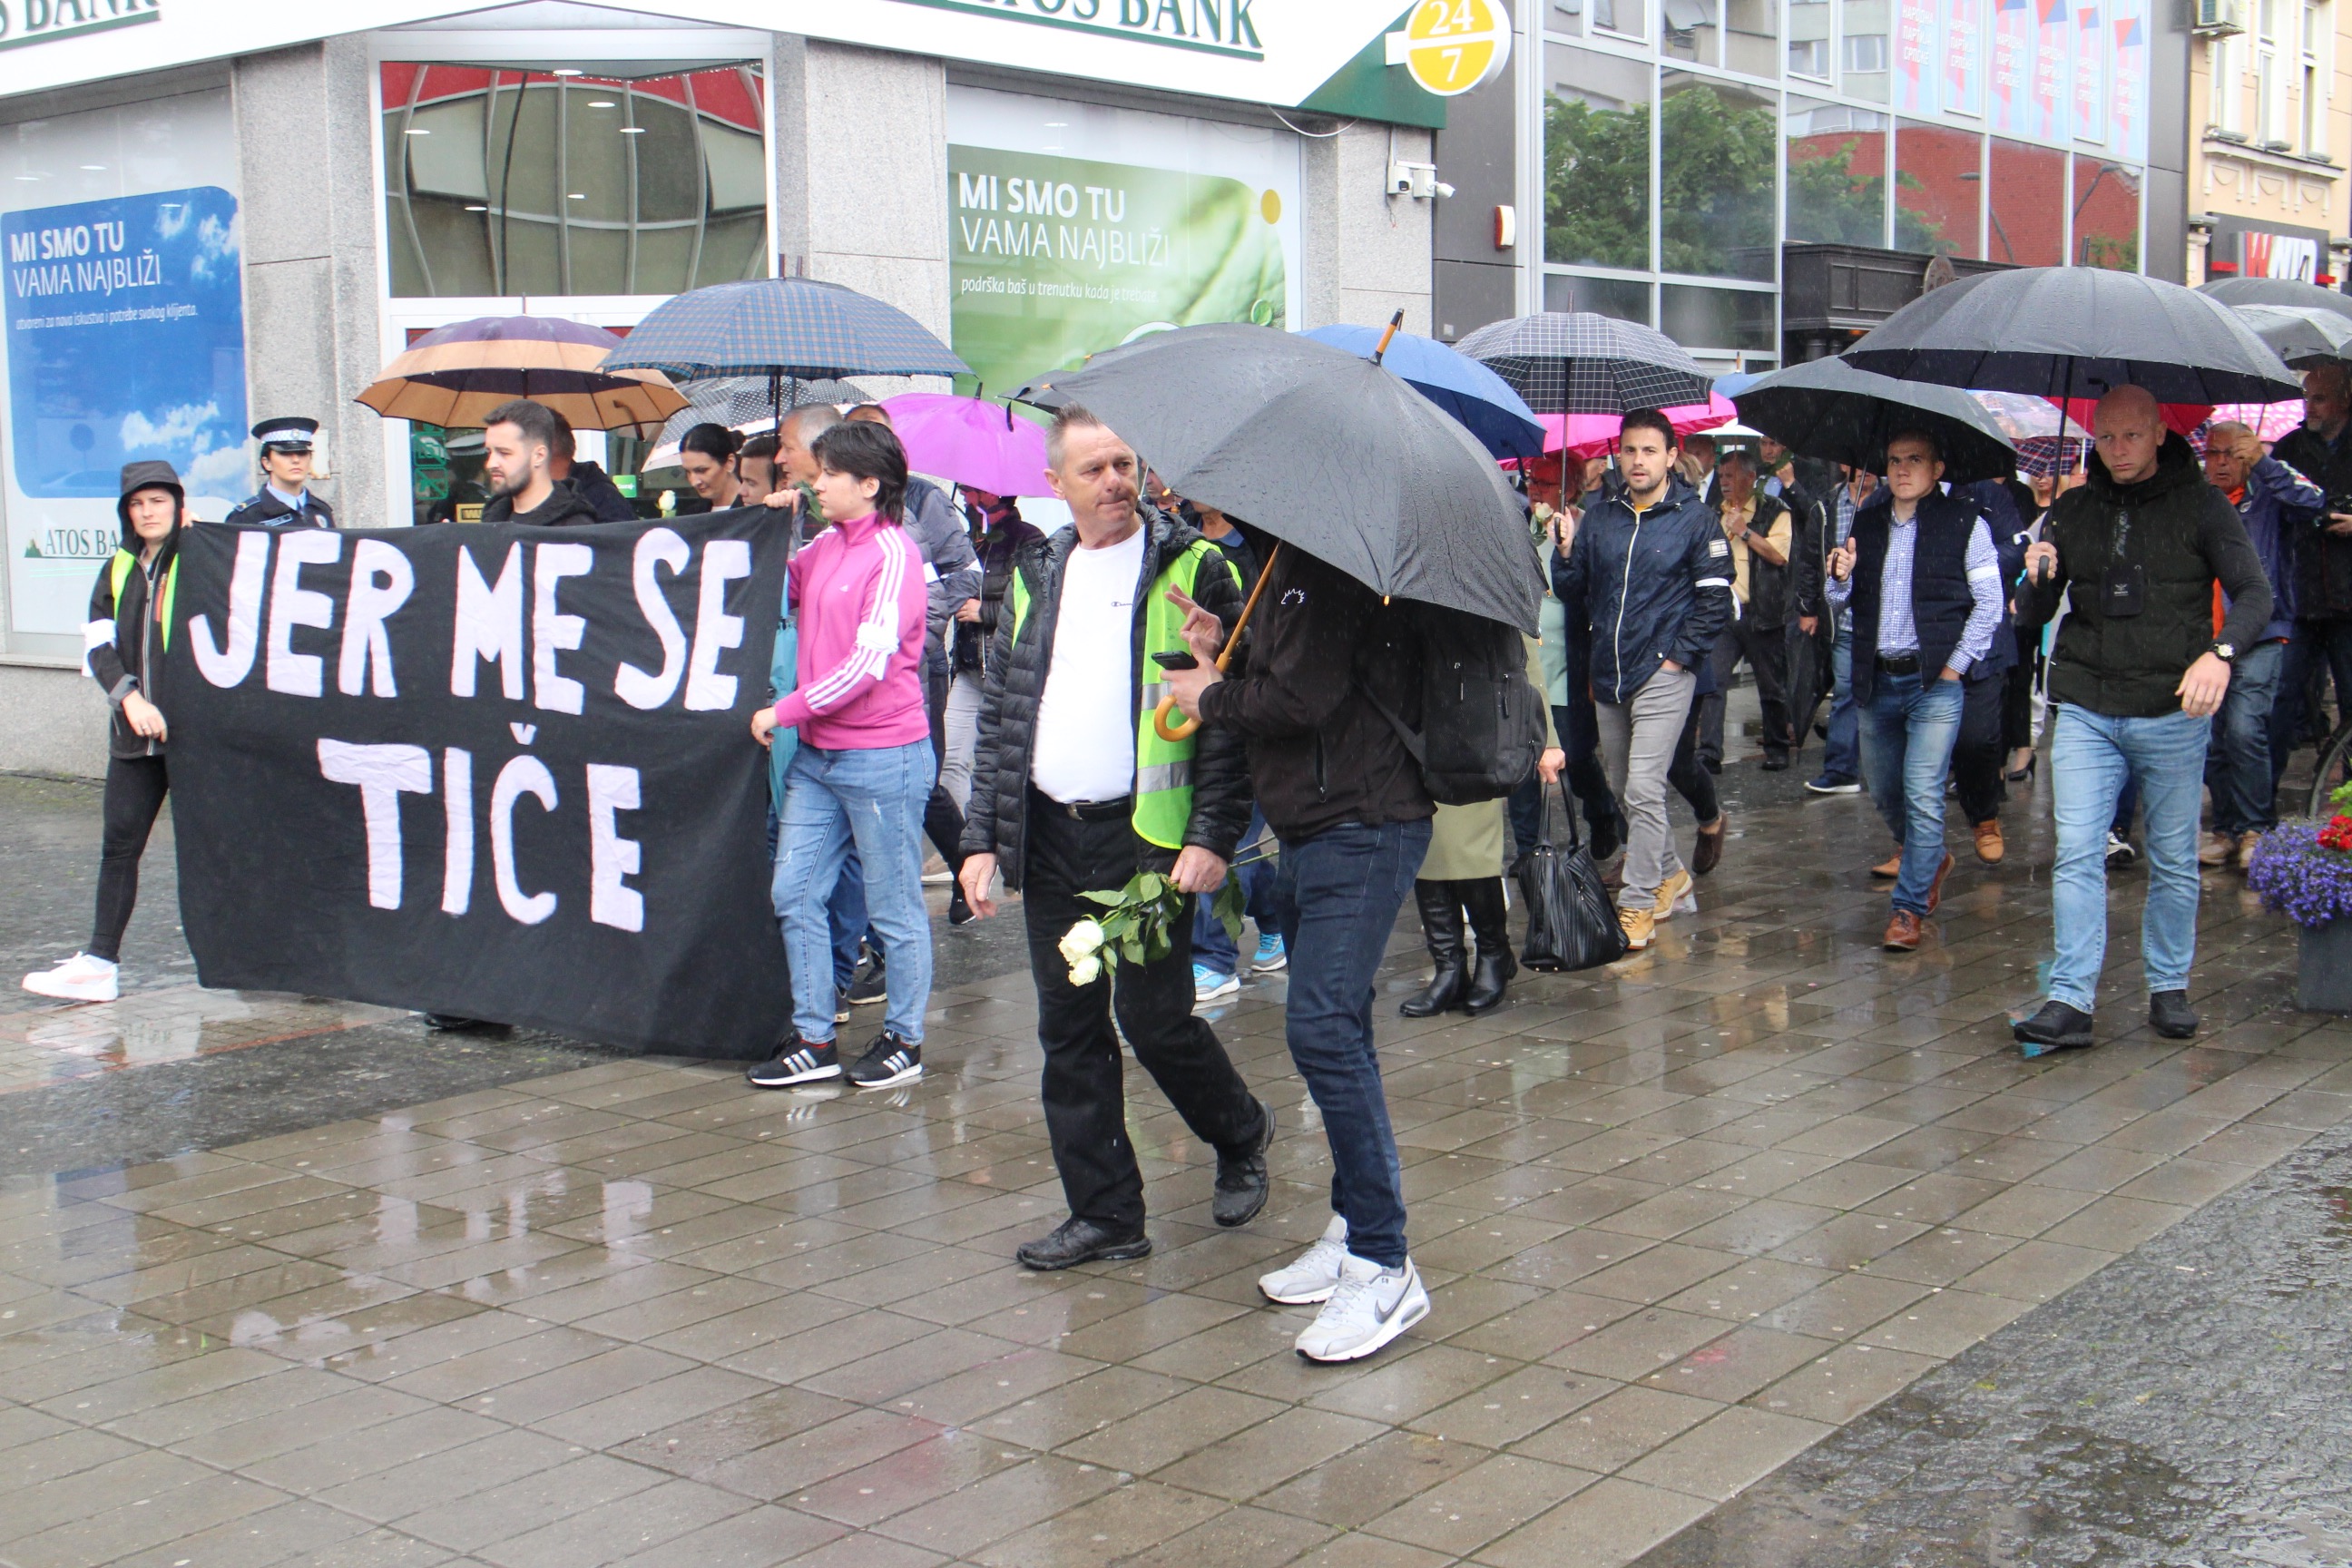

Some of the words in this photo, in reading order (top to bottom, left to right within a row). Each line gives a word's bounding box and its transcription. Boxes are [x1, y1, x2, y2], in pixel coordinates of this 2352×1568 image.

[1429, 0, 1475, 35] 24
[1441, 47, 1463, 83] 7
[959, 172, 997, 211] MI
[1007, 178, 1078, 218] SMO
[1085, 186, 1124, 222] TU
[11, 231, 36, 262] MI
[41, 225, 90, 260] SMO
[93, 220, 124, 253] TU
[960, 216, 1052, 258] VAMA
[1060, 225, 1169, 270] NAJBLIŽI
[14, 264, 74, 298] VAMA
[77, 249, 161, 297] NAJBLIŽI
[961, 276, 1004, 295] podrška
[1007, 278, 1026, 295] baš
[1029, 282, 1035, 295] u
[1038, 281, 1083, 299] trenutku
[1084, 283, 1109, 300] kada
[1110, 286, 1120, 304] je
[74, 311, 103, 326] iskustva
[110, 307, 138, 326] potrebe
[139, 305, 165, 323] svakog
[45, 529, 91, 555] ATOS
[95, 530, 120, 556] BA
[189, 529, 415, 698] JER
[451, 541, 594, 715] ME
[614, 527, 751, 711] SE
[317, 722, 644, 932] TIČE
